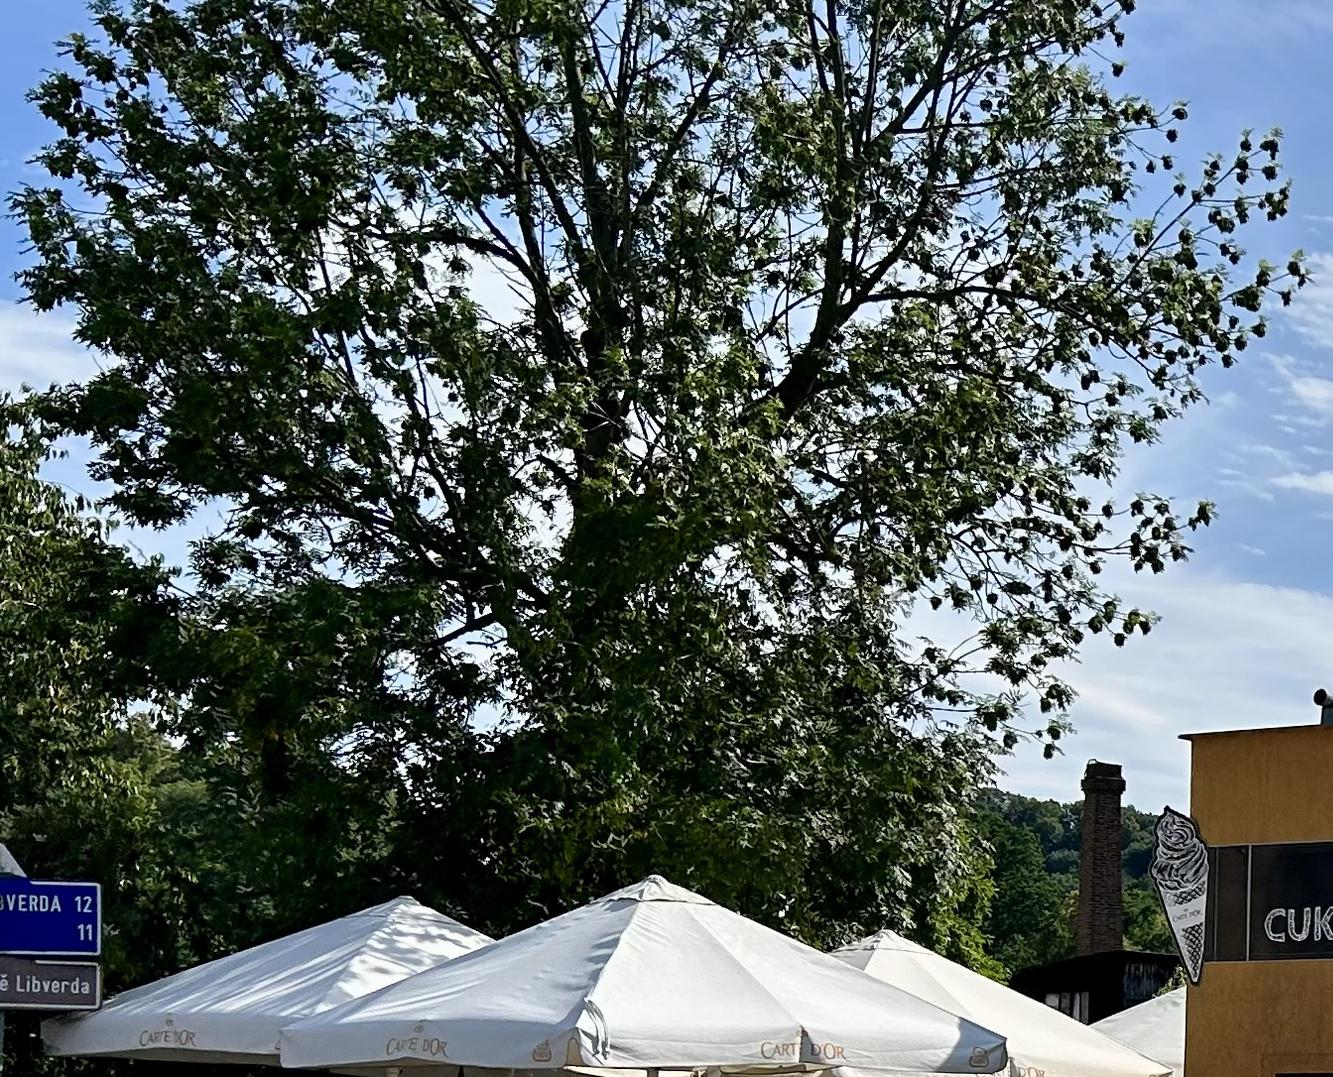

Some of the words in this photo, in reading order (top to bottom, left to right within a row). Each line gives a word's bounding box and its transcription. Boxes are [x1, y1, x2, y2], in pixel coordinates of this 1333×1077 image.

[74, 896, 93, 913] 12
[77, 923, 93, 941] 11
[16, 974, 90, 994] Libverda
[760, 1041, 798, 1060] CART
